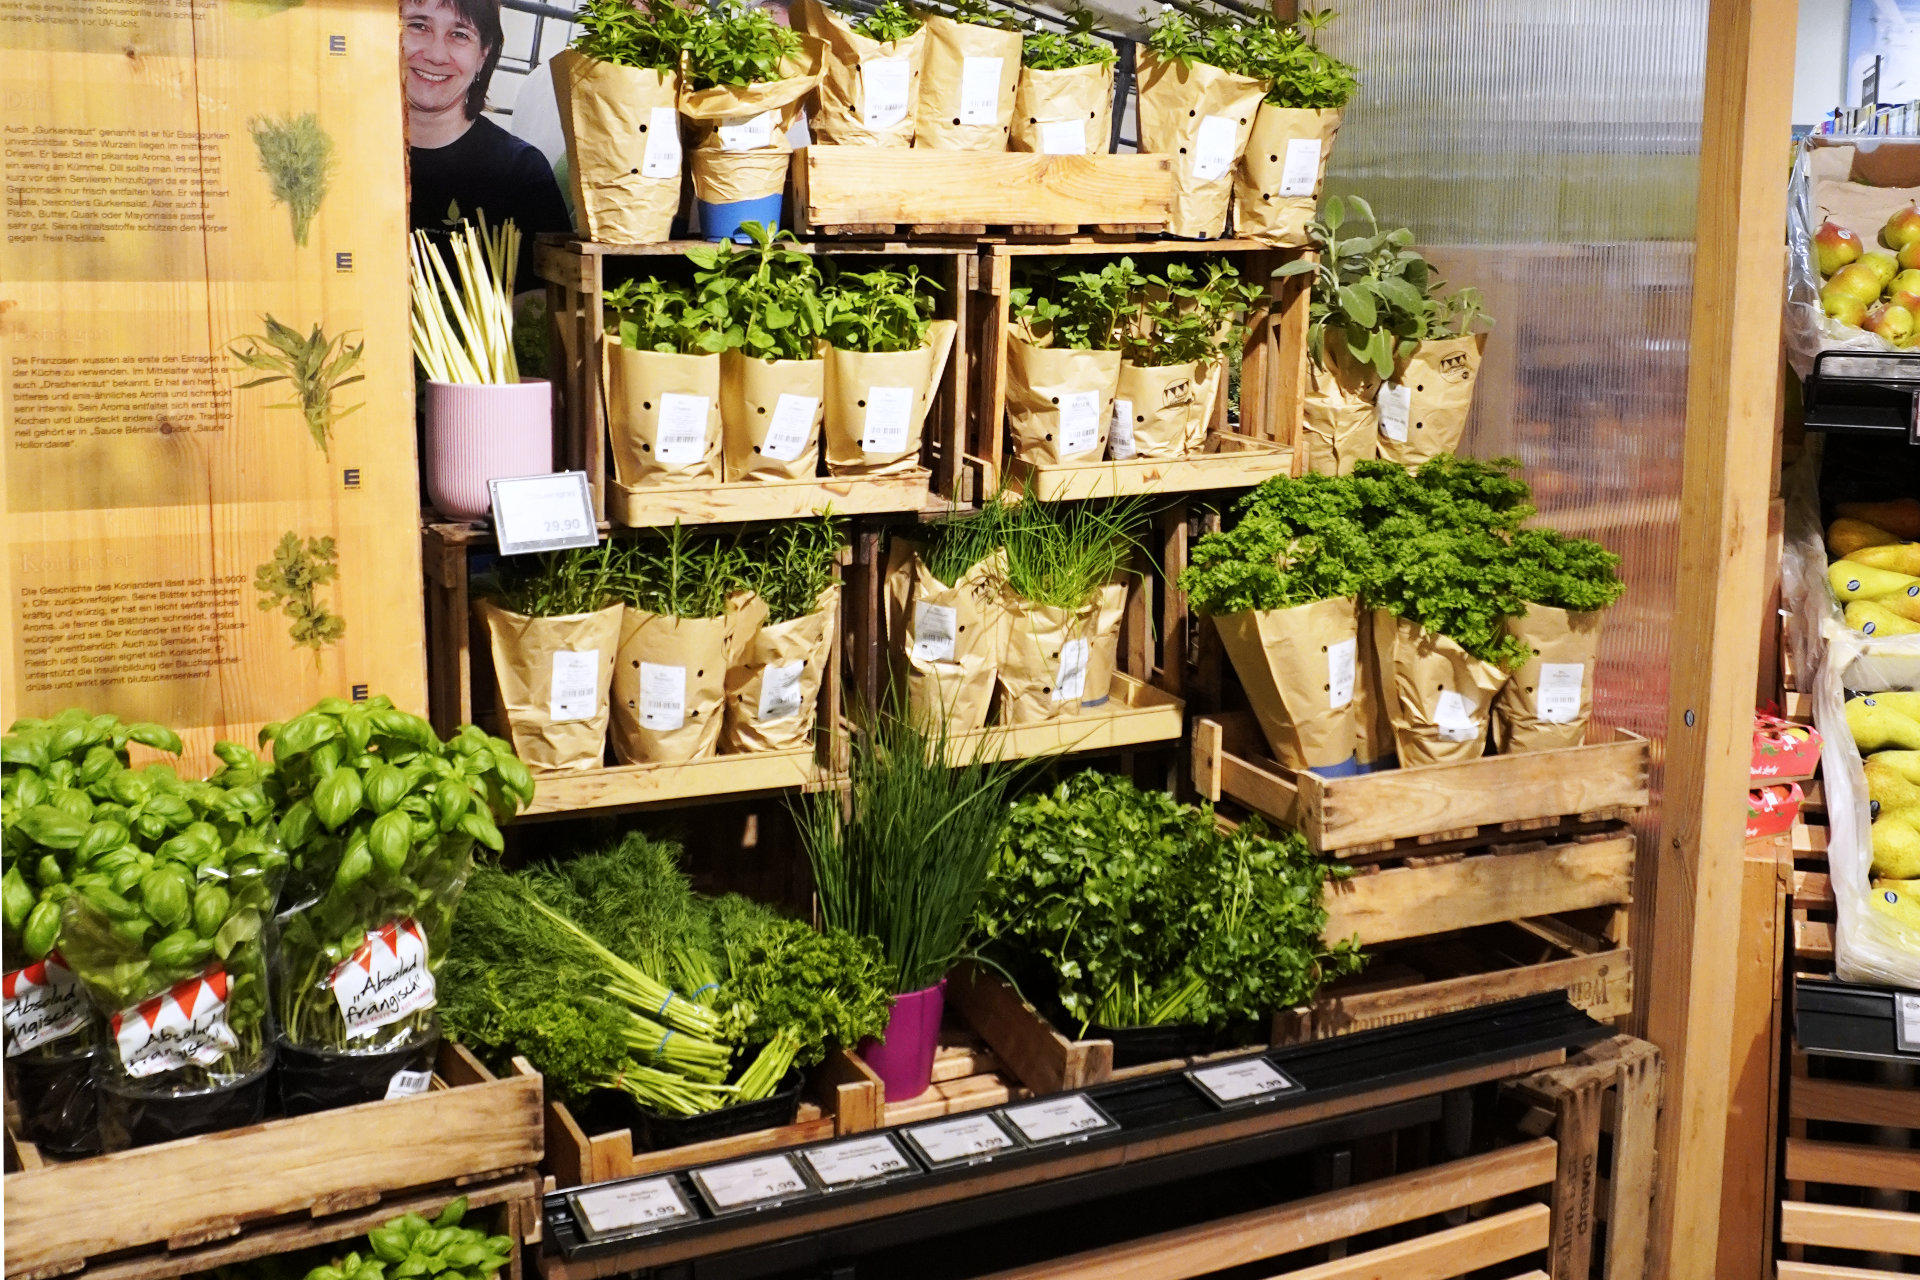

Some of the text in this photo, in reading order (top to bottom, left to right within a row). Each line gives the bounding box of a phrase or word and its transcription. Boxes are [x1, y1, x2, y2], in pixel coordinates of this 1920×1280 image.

[4, 125, 28, 134] Auch
[99, 128, 136, 138] genannt
[101, 140, 136, 148] Wurzeln
[138, 141, 164, 151] liegen
[167, 141, 177, 149] im
[39, 150, 49, 158] Er
[85, 151, 99, 159] ein
[102, 152, 139, 162] pikantes
[109, 163, 123, 171] Dill
[126, 164, 149, 172] sollte
[166, 176, 177, 184] da
[42, 198, 90, 207] besonders
[152, 200, 172, 208] Aber
[175, 200, 197, 208] auch
[72, 211, 98, 219] Quark
[101, 211, 122, 219] oder
[180, 223, 195, 231] den
[12, 357, 28, 365] Die
[30, 356, 78, 365] Franzosen
[12, 368, 28, 376] der
[31, 368, 61, 376] Küche
[13, 380, 36, 388] auch
[183, 377, 195, 385] ein
[51, 392, 69, 400] und
[140, 390, 168, 398] Aroma
[171, 390, 187, 398] und
[78, 403, 98, 411] Sein
[100, 402, 130, 410] Aroma
[15, 413, 153, 424] Kochen und überdeckt andere
[21, 587, 36, 596] Die
[39, 584, 92, 595] Geschichte
[95, 583, 111, 592] des
[55, 608, 72, 617] und
[101, 617, 115, 626] die
[106, 629, 122, 637] Der
[198, 623, 211, 631] die
[122, 639, 144, 648] Auch
[61, 655, 78, 664] und
[78, 666, 92, 675] die
[55, 680, 72, 689] und
